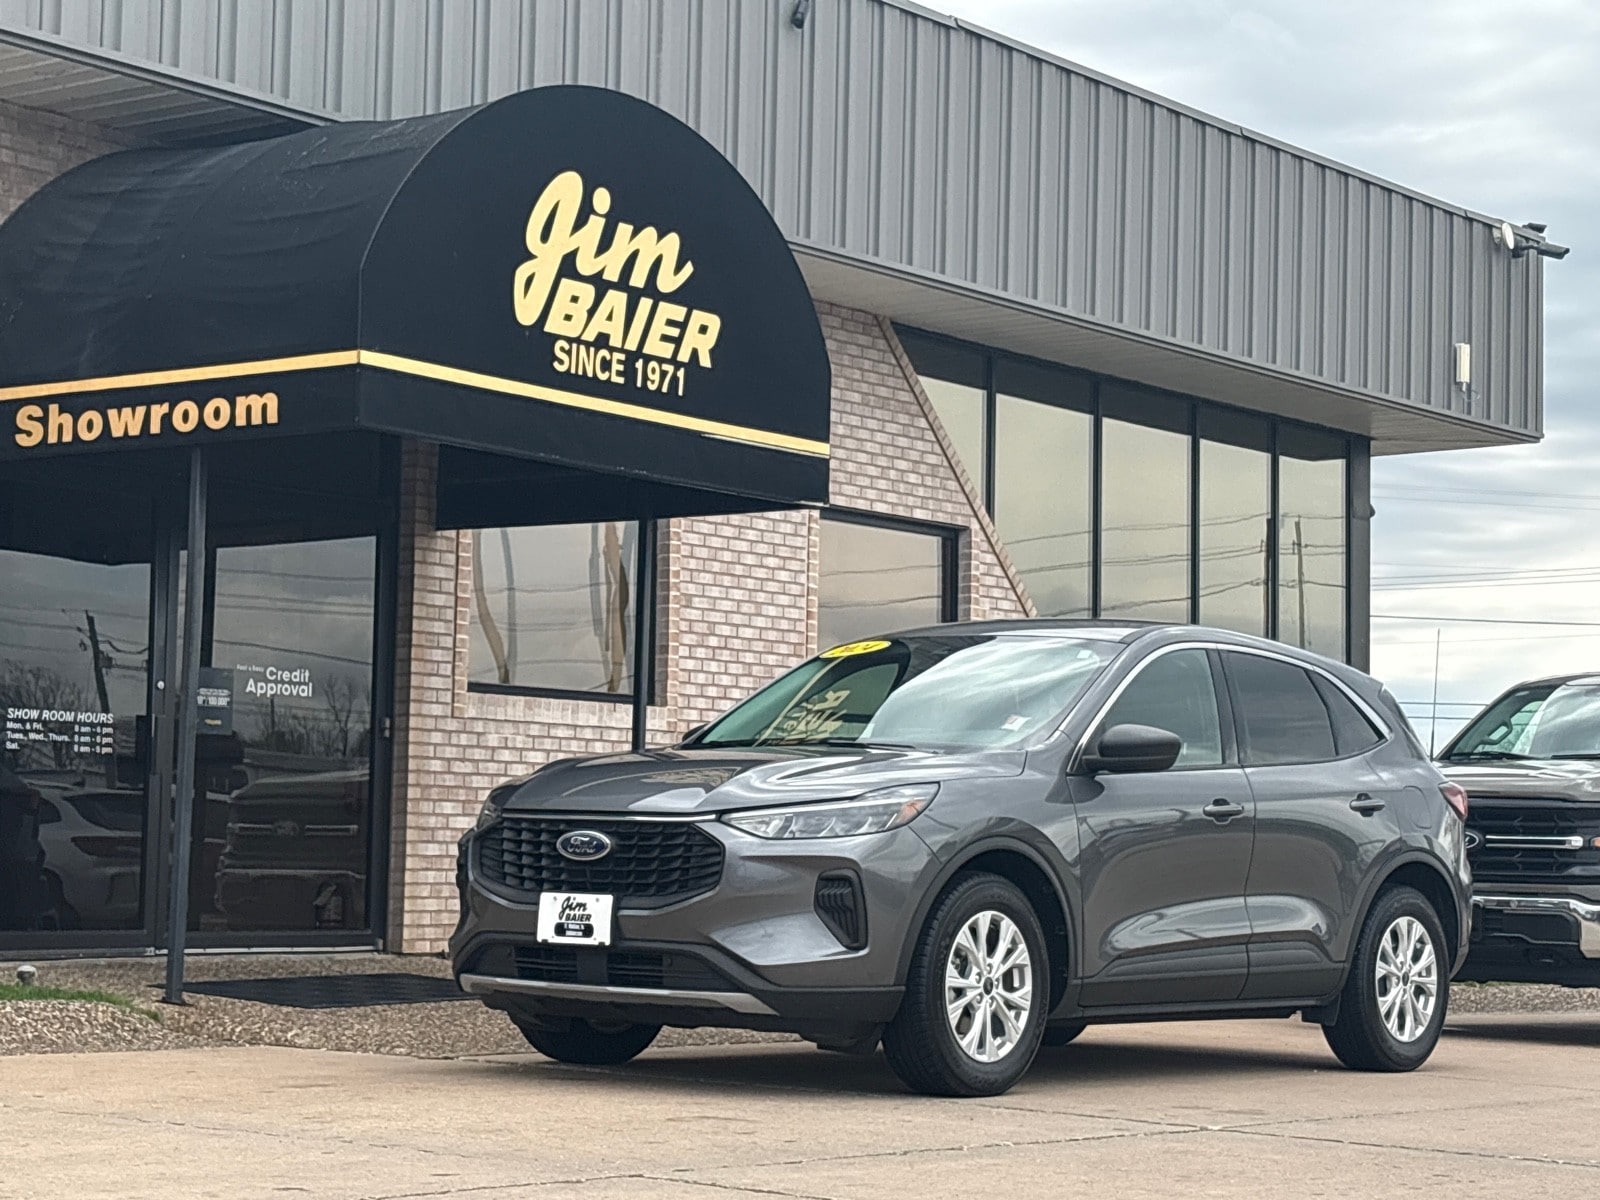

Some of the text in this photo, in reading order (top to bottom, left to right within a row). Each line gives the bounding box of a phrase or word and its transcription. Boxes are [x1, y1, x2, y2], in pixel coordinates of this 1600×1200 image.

[514, 171, 694, 326] Jim
[543, 277, 722, 368] BAIER
[553, 339, 685, 397] SINCE 1971
[15, 391, 279, 447] Showroom
[266, 666, 310, 683] Credit
[245, 678, 313, 697] Approval
[7, 708, 114, 723] SHOW ROOM HOURS
[558, 896, 588, 921] Jim
[565, 913, 592, 922] BAIER
